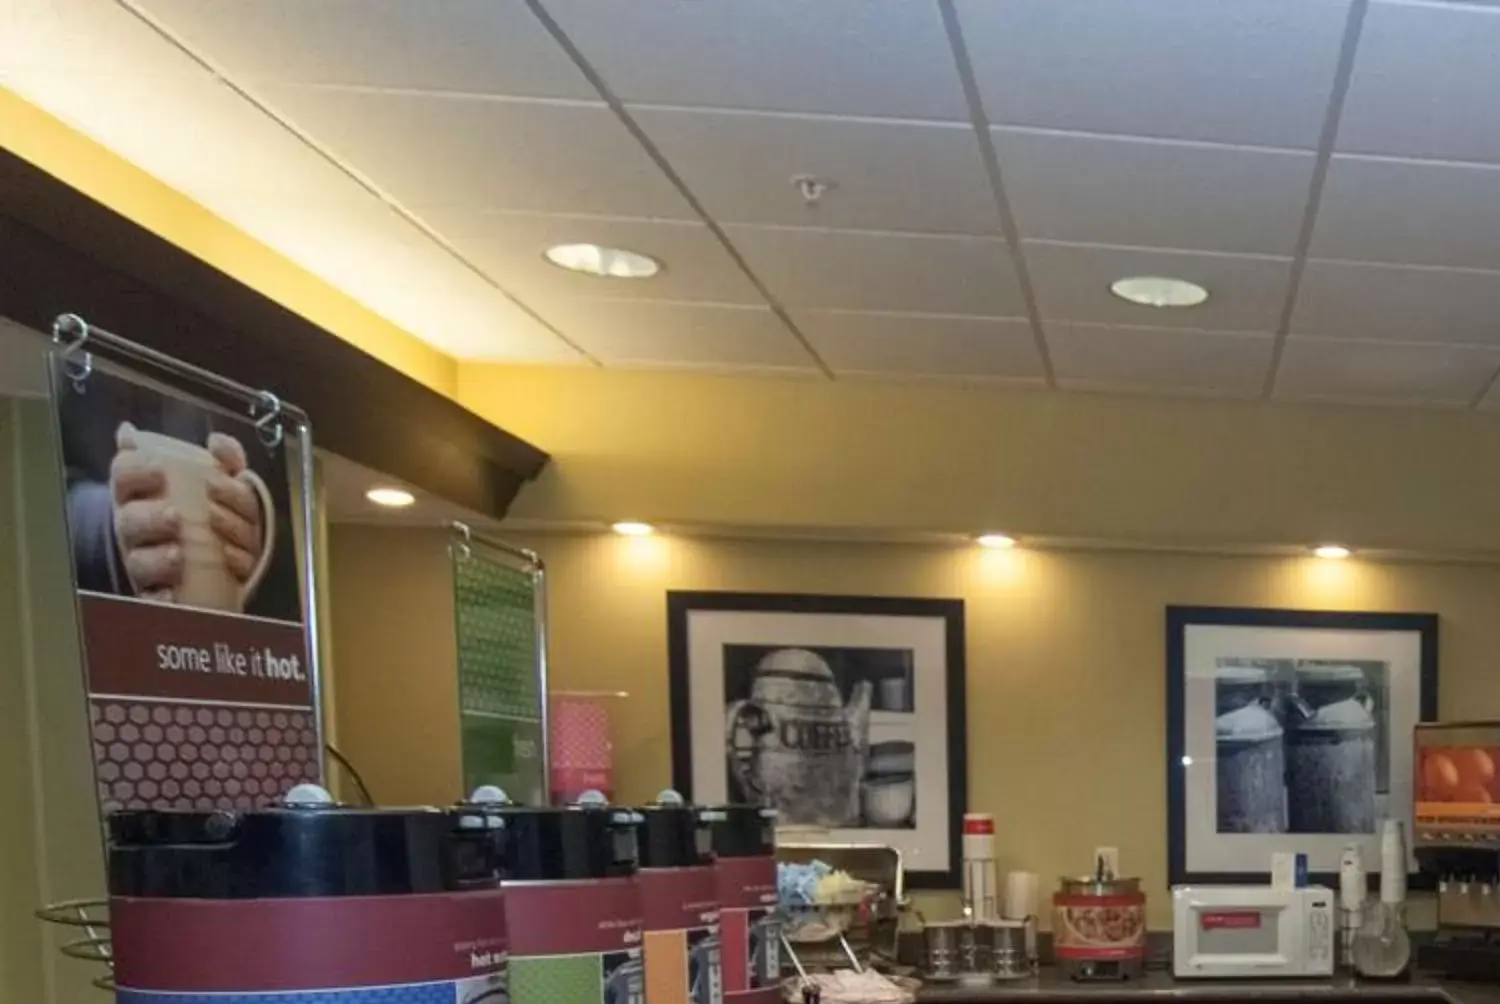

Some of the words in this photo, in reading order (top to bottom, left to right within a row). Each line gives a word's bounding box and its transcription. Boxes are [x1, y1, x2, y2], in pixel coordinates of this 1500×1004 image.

[157, 643, 211, 673] some
[213, 641, 247, 675] like
[250, 647, 264, 677] it
[265, 647, 306, 681] hot.
